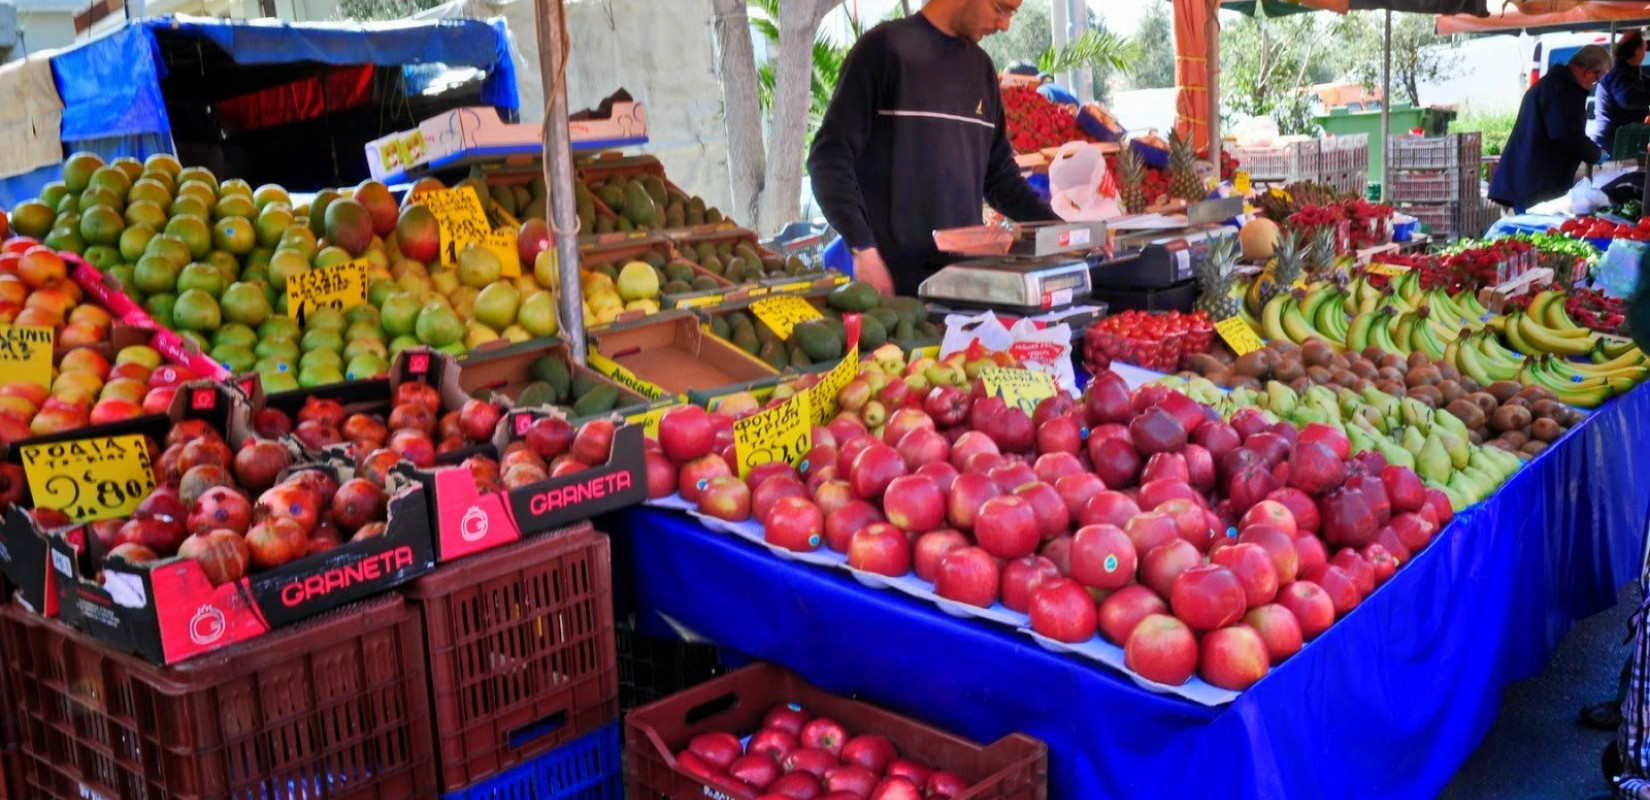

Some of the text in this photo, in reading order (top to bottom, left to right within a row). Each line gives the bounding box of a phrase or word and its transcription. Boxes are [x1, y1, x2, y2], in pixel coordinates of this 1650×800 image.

[611, 367, 660, 401] Avocado
[24, 437, 126, 465] ΡΟΔΙΑ
[530, 470, 632, 516] GRANETA
[281, 545, 414, 607] GRANETA
